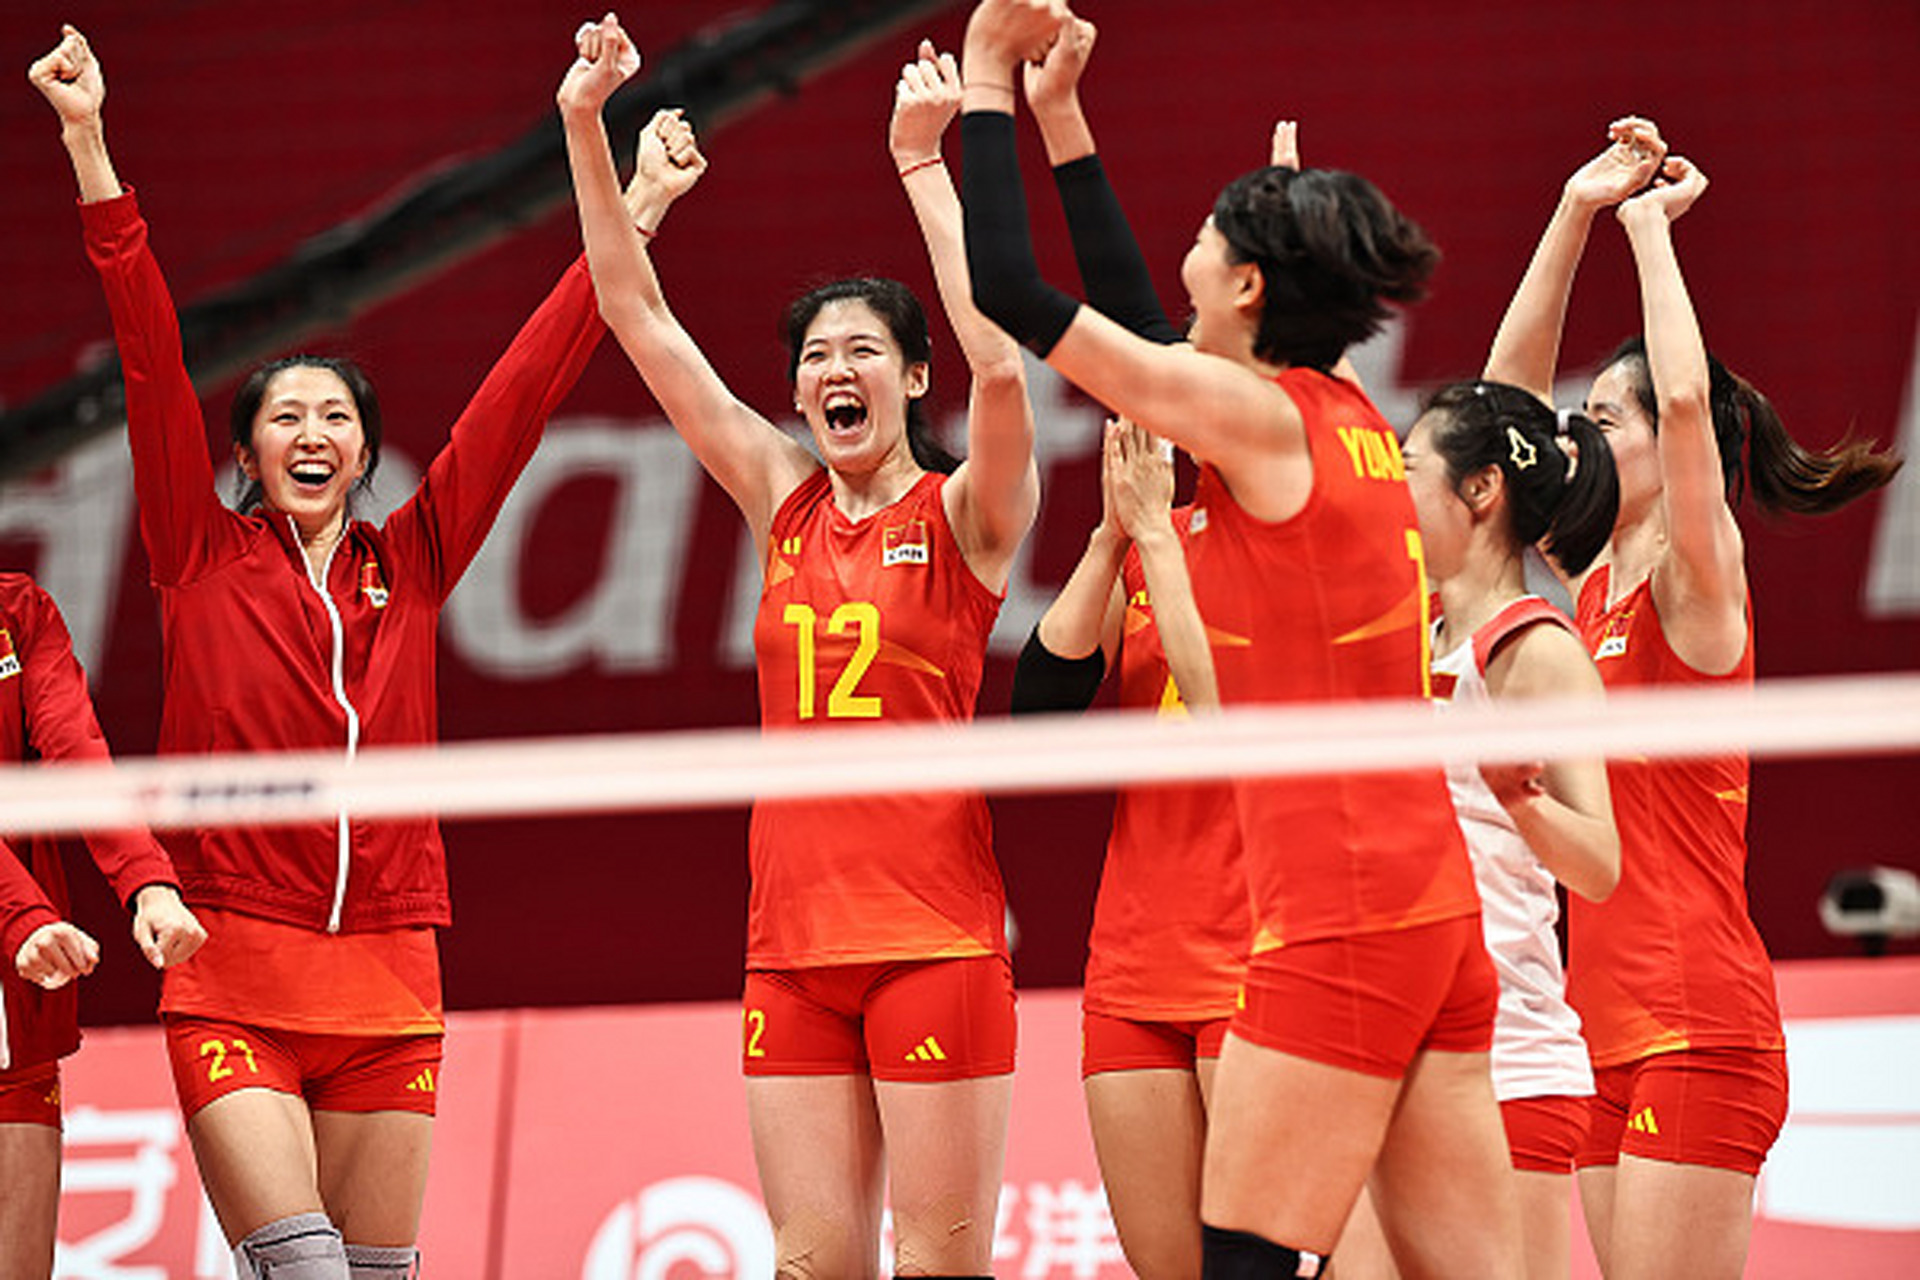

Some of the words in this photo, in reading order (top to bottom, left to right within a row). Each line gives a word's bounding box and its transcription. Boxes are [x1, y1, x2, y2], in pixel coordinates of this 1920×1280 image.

[784, 602, 882, 719] 12
[741, 1008, 765, 1057] 2
[200, 1039, 259, 1082] 21
